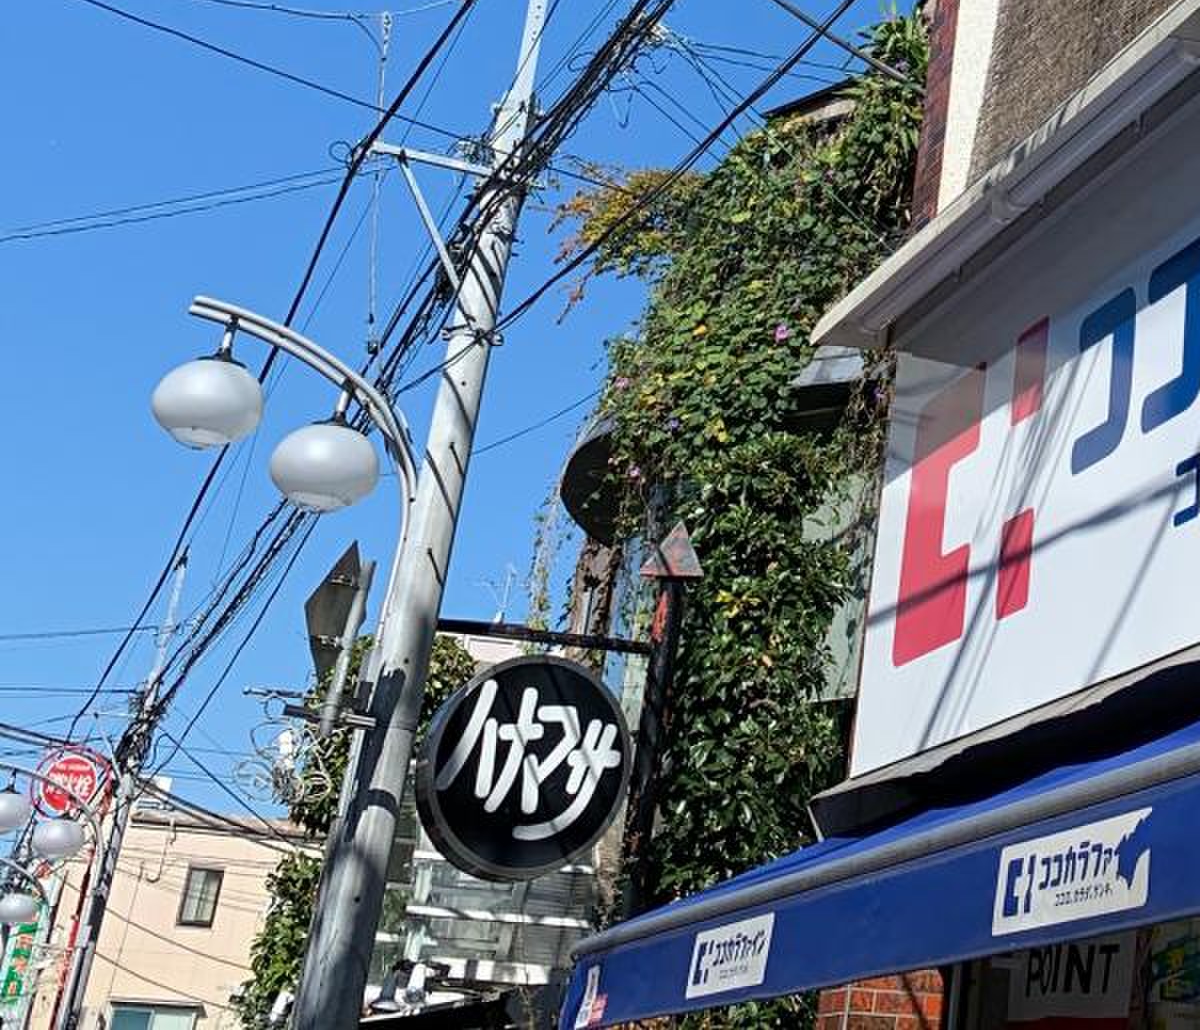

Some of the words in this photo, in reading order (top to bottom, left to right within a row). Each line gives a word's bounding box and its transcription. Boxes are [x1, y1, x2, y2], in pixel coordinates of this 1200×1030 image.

[1039, 838, 1122, 891] ココカラファ
[1023, 943, 1121, 998] POINT
